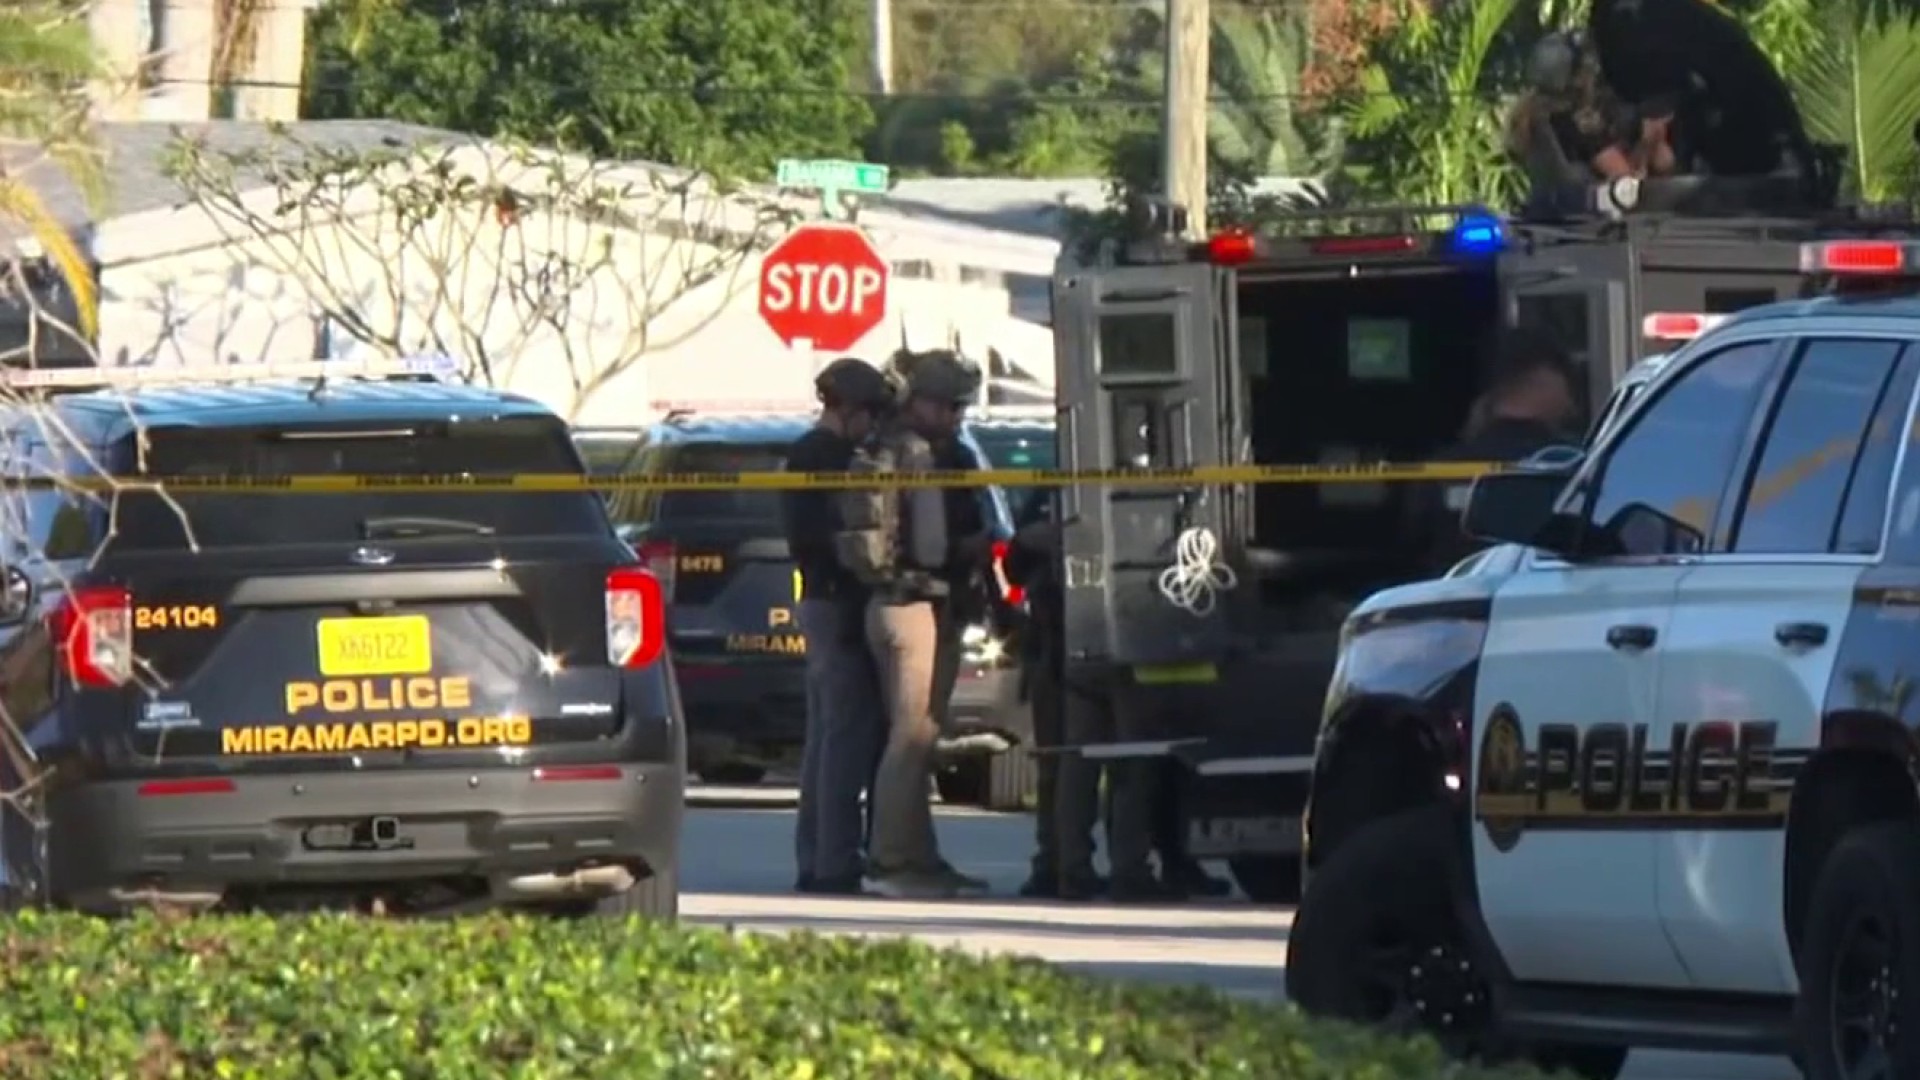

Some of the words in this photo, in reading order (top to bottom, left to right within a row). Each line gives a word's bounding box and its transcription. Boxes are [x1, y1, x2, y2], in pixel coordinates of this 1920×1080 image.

[765, 263, 881, 316] STOP
[135, 605, 217, 629] 24104
[726, 632, 807, 654] MIRAM
[286, 677, 471, 714] POLICE
[222, 717, 530, 754] MIRAMARPD.ORG
[1537, 720, 1778, 811] POLICE
